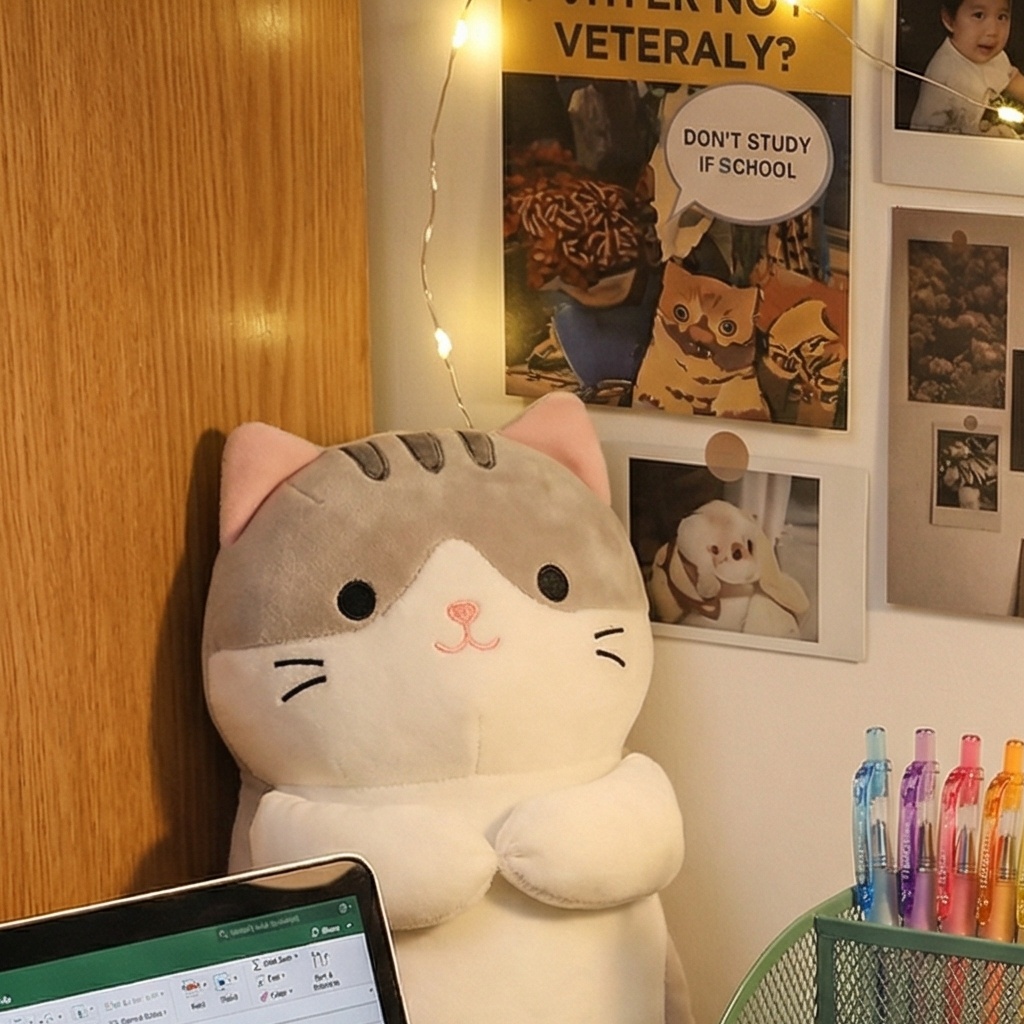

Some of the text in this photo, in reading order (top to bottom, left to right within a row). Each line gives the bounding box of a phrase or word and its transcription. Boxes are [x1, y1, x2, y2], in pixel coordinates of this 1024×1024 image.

[554, 22, 797, 72] VETERALY?
[684, 128, 811, 154] DON'T STUDY
[699, 156, 797, 179] IF SCHOOL
